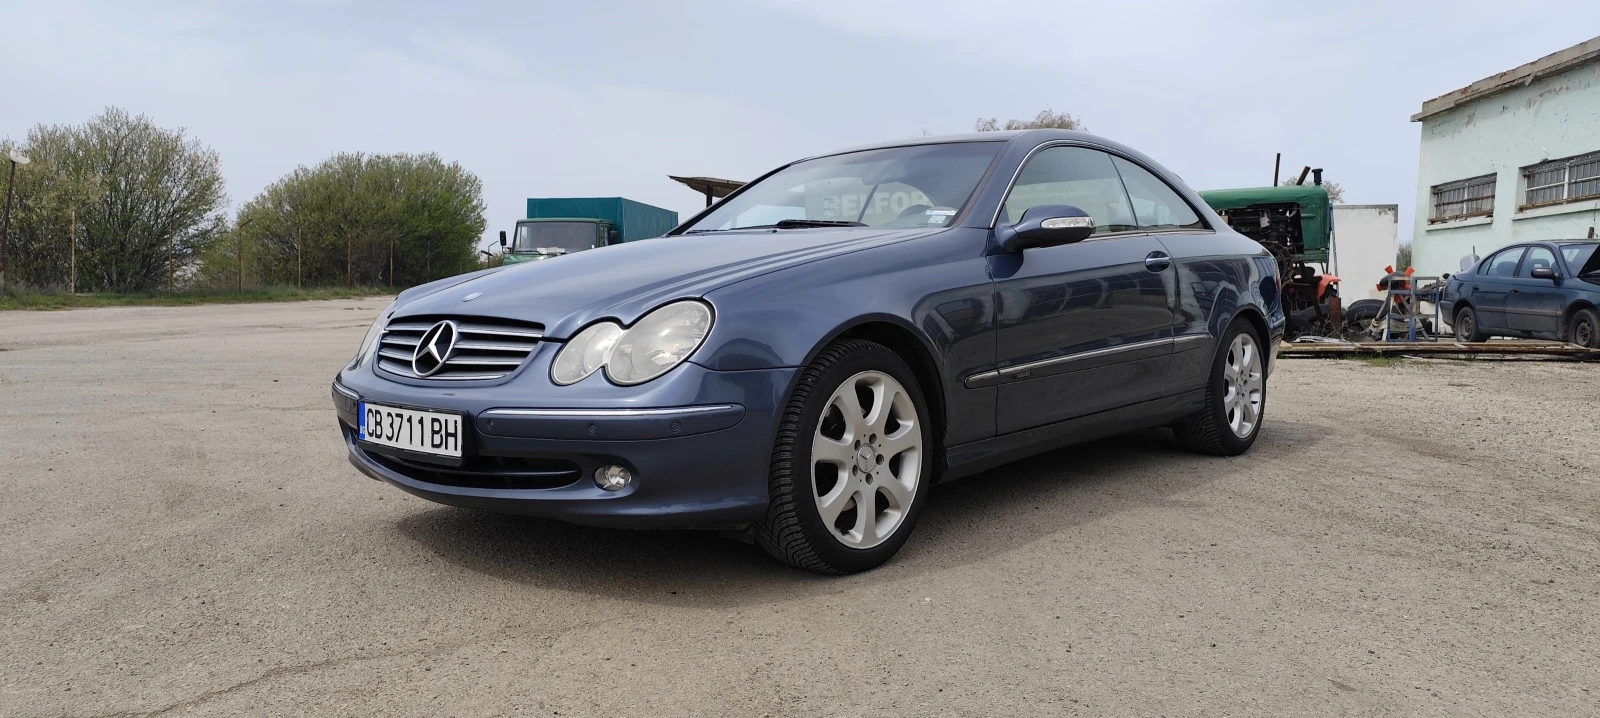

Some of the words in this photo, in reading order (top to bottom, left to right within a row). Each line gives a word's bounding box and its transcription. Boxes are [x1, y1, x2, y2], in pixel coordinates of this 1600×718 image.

[367, 408, 383, 439] CB
[386, 412, 424, 446] 3711
[431, 418, 458, 451] BH
